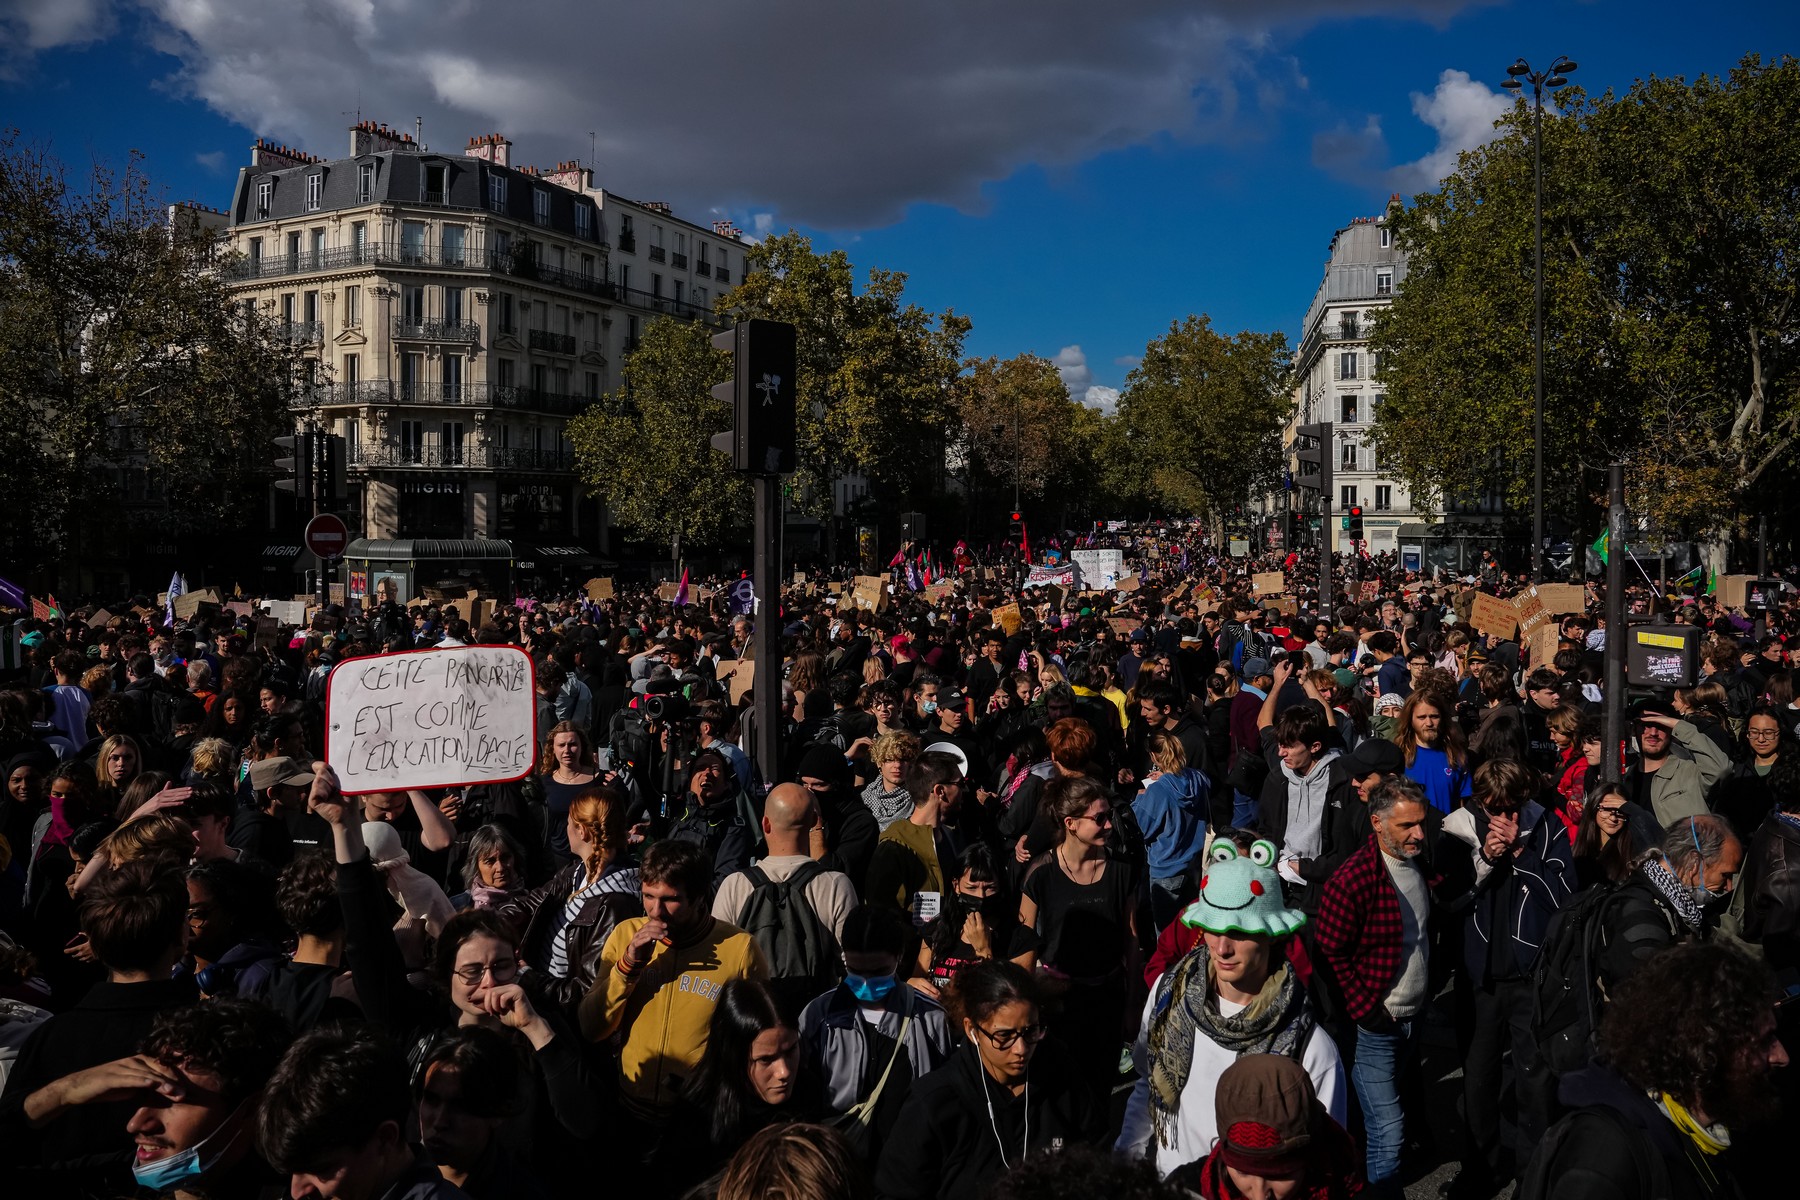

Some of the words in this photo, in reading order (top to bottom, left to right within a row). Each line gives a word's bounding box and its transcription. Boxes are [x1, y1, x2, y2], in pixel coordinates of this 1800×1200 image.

[262, 545, 302, 556] NIGIRI
[361, 657, 432, 690] CETTE
[354, 701, 403, 736] EST
[415, 694, 489, 731] COMME
[679, 974, 722, 1002] RICH
